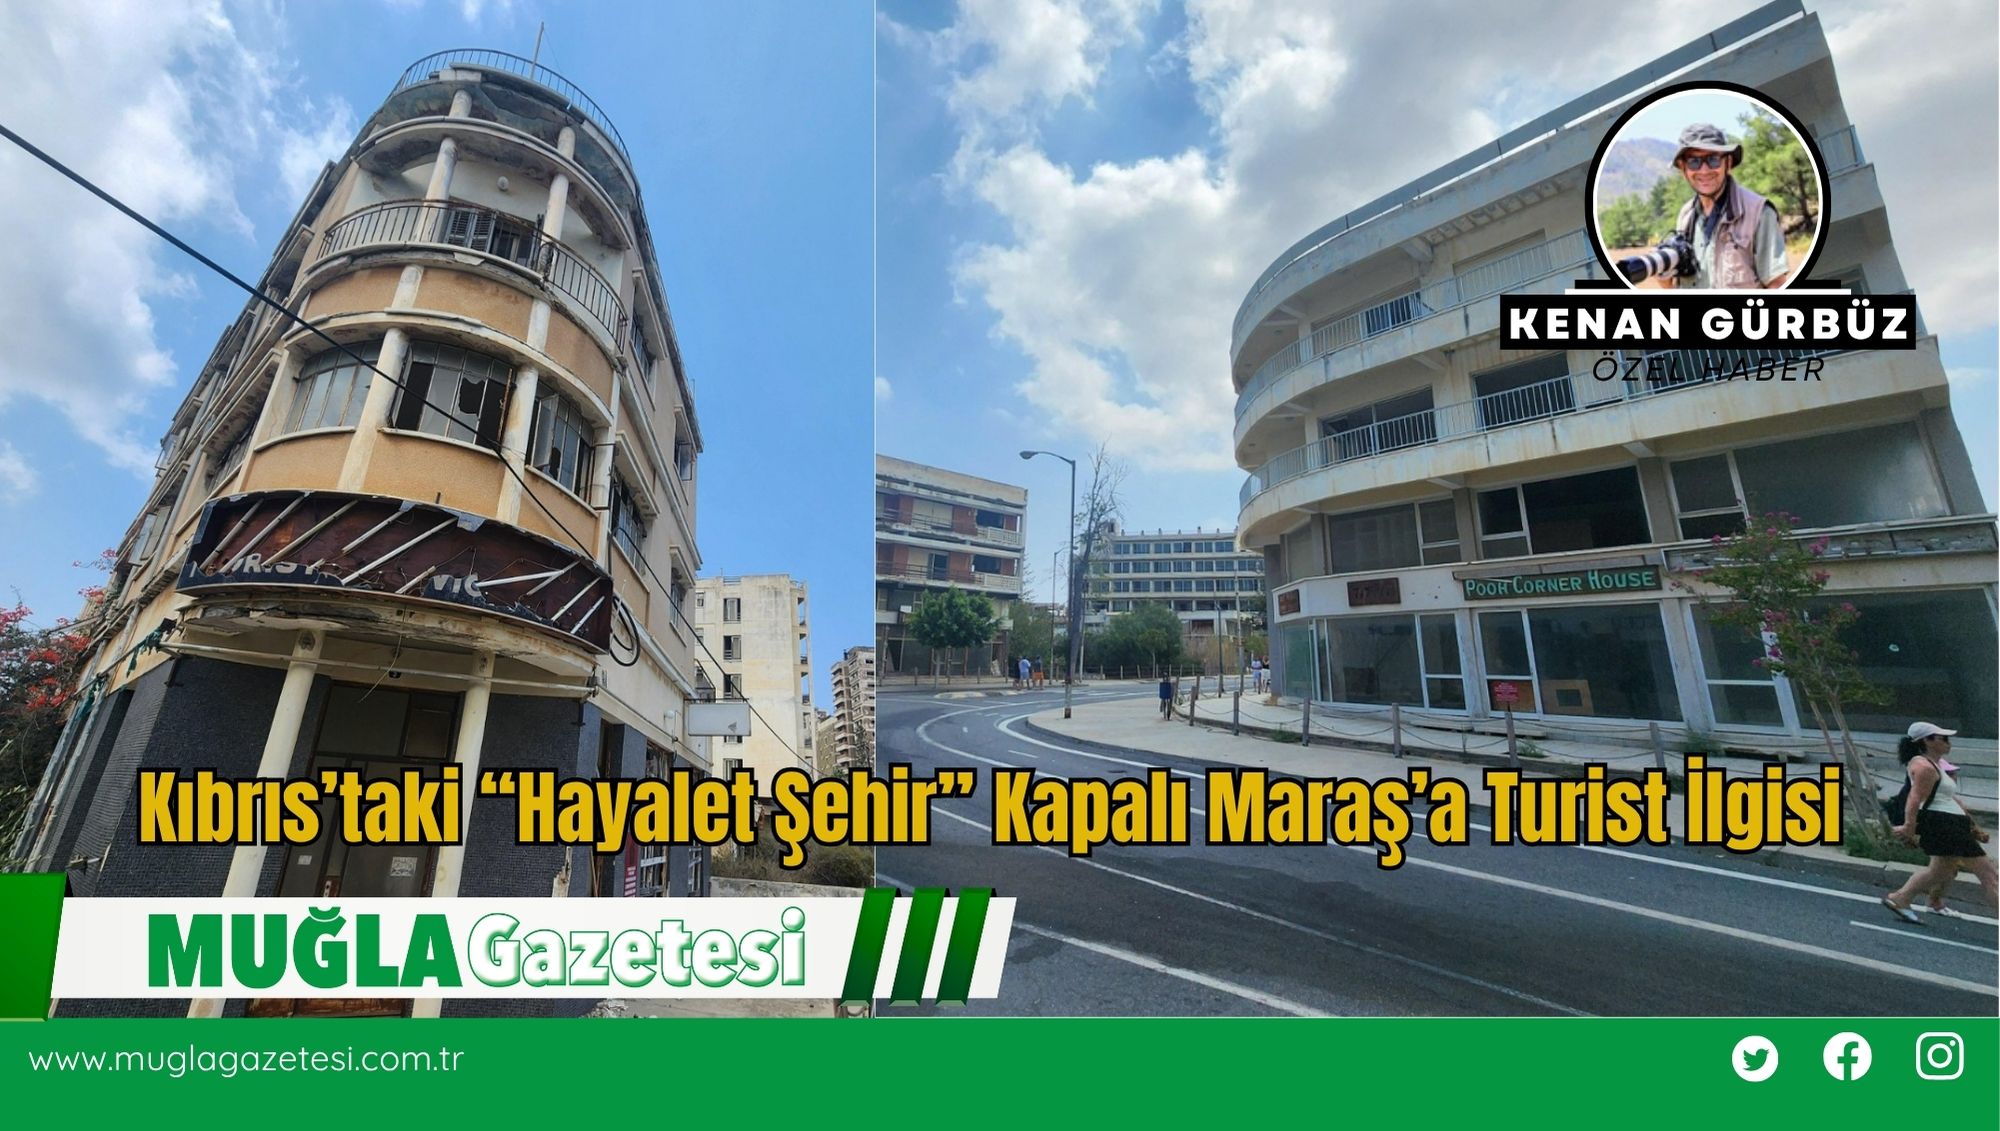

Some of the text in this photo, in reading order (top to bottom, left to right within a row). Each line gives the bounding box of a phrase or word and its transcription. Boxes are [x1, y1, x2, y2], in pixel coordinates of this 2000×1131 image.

[1465, 570, 1657, 597] POOH CORNER HOUSE
